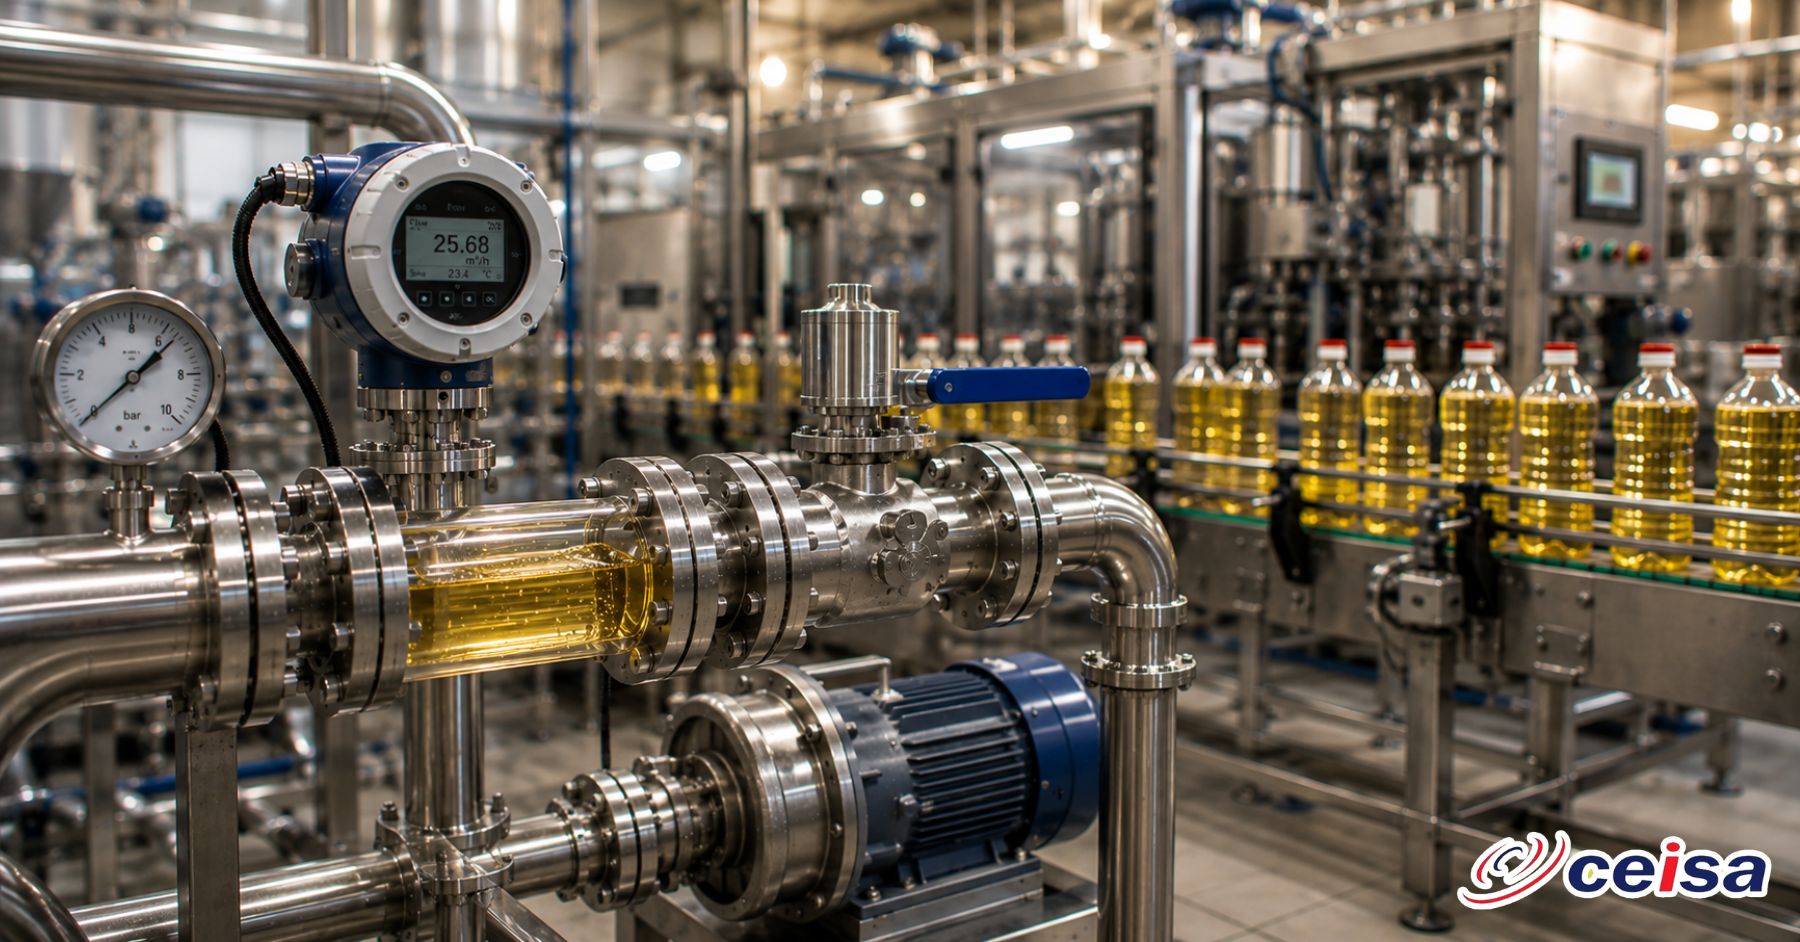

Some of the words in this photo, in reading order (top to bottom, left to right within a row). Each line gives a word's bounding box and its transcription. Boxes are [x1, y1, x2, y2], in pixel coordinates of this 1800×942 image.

[433, 234, 489, 254] 25.68
[448, 269, 469, 279] 23.4
[98, 335, 106, 347] 4
[155, 335, 162, 347] 6
[76, 369, 84, 381] 2
[177, 369, 185, 381] 8
[123, 410, 141, 420] bar
[161, 404, 172, 416] 10
